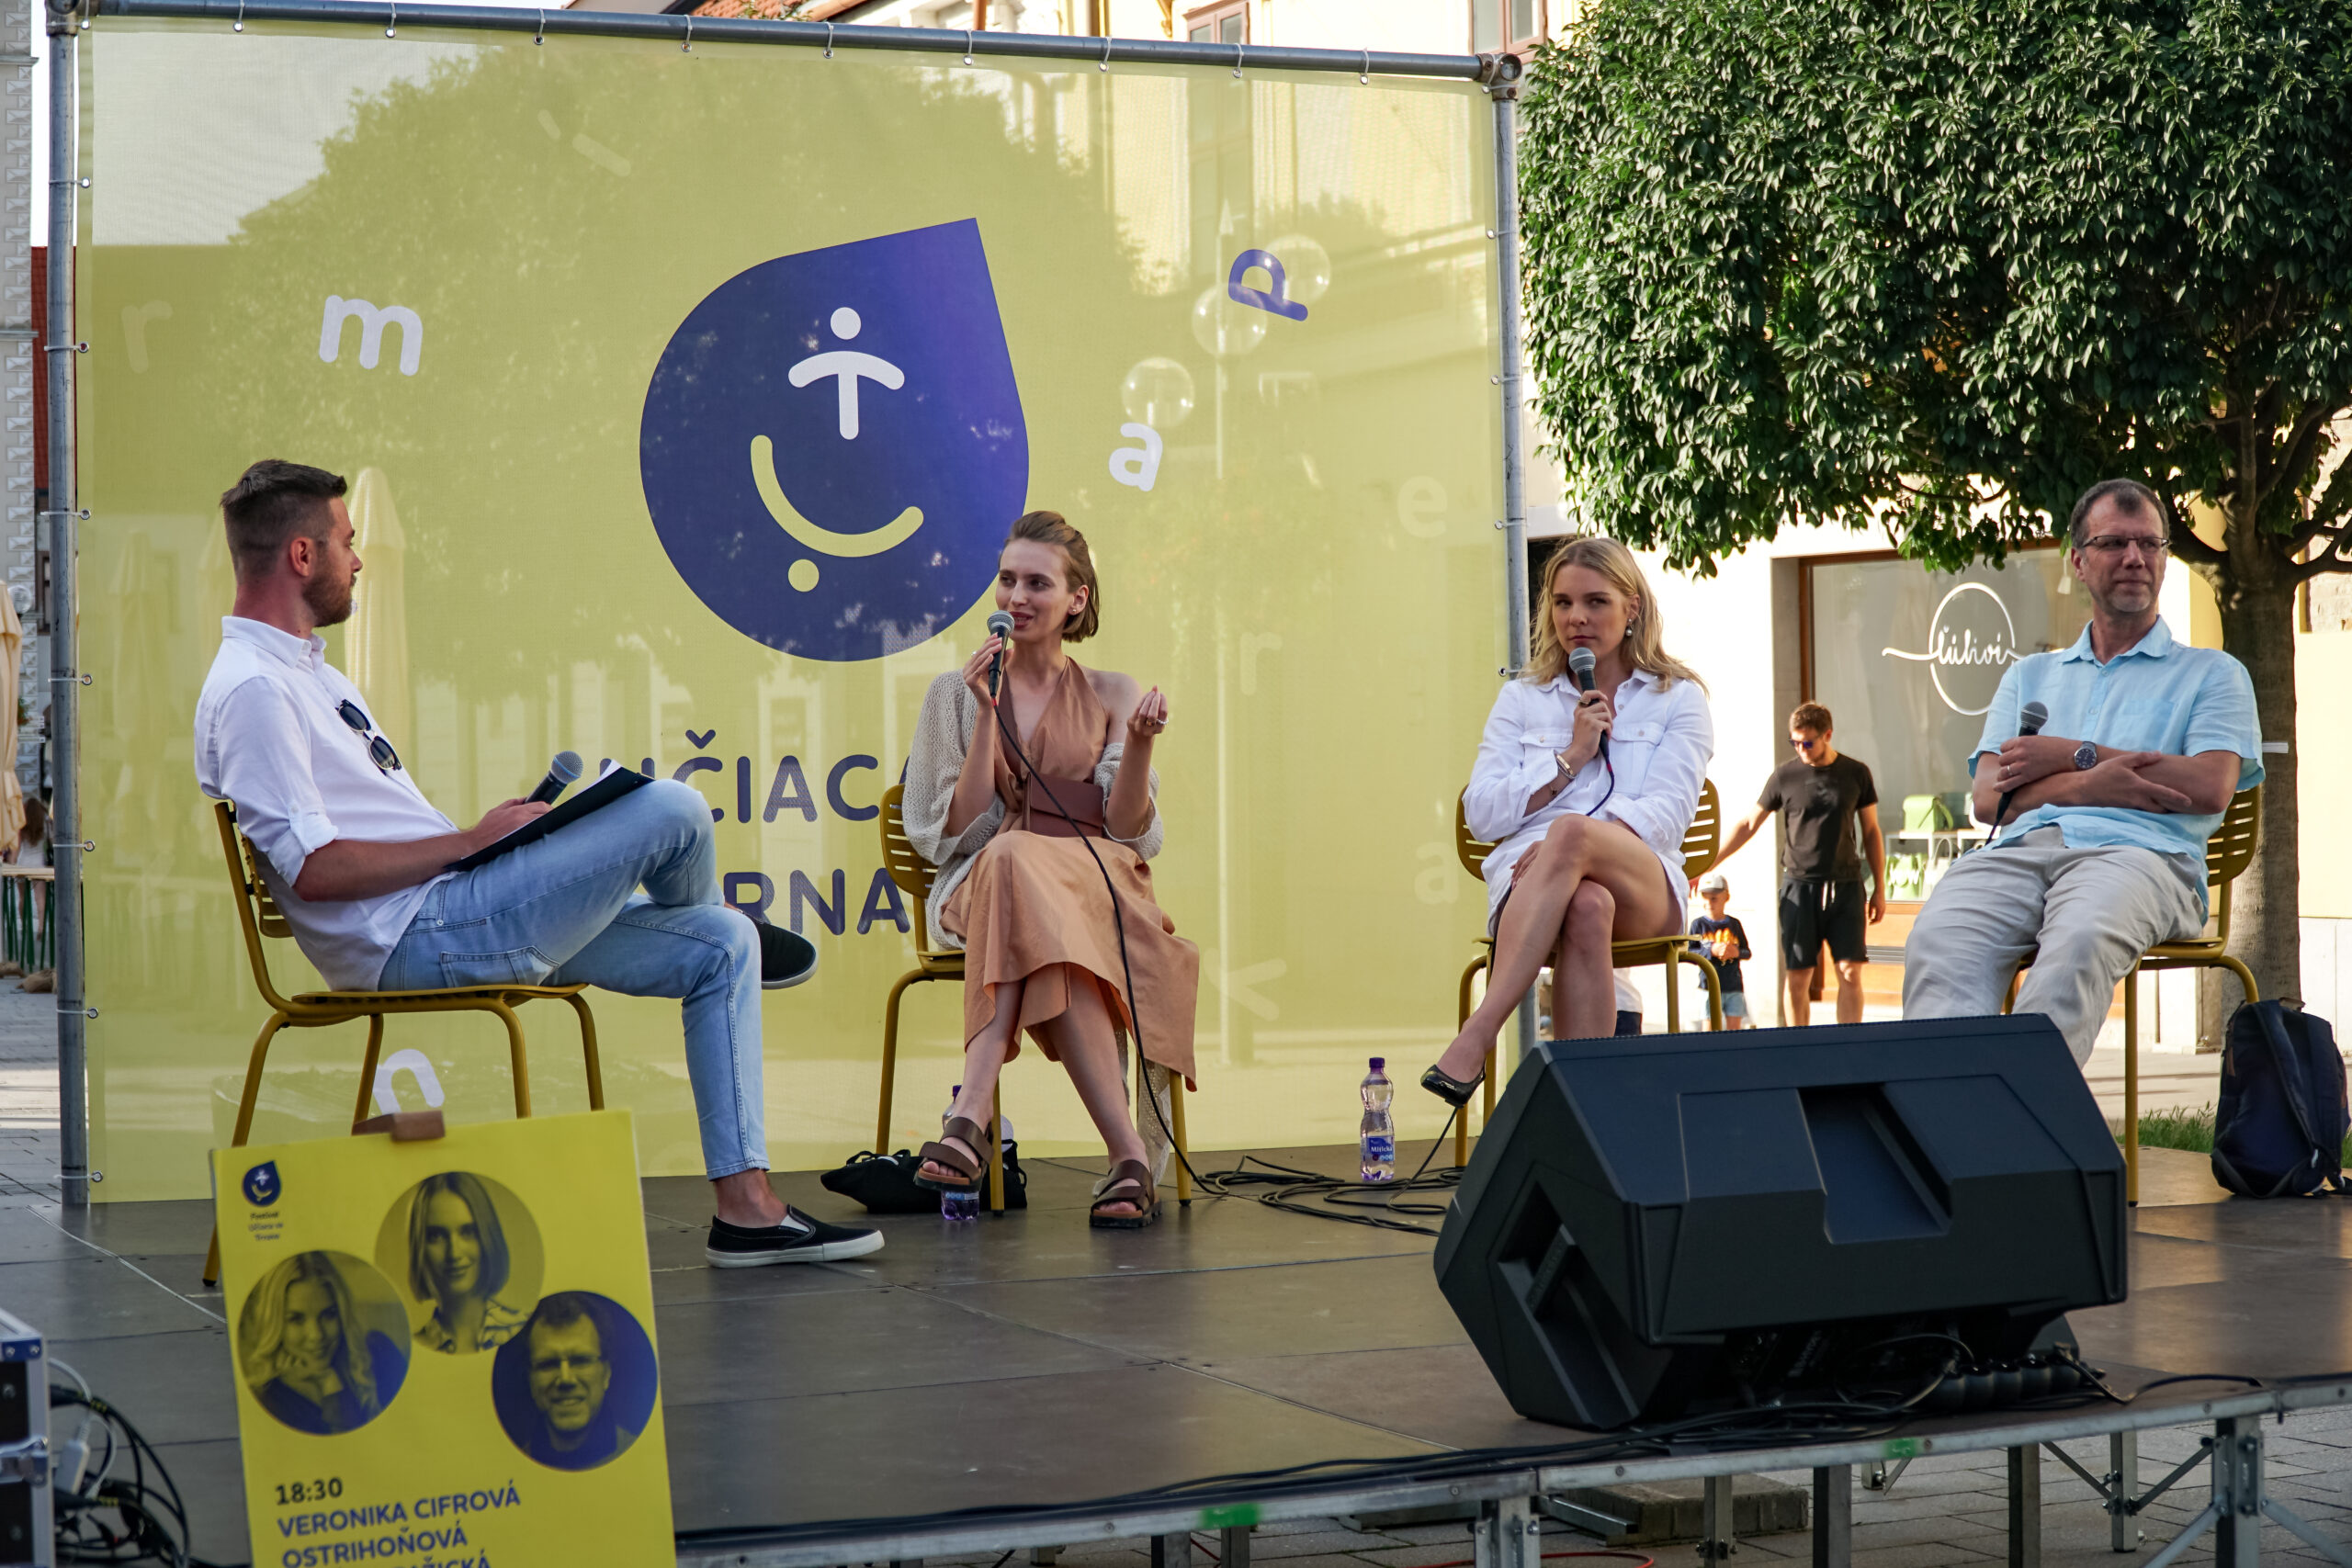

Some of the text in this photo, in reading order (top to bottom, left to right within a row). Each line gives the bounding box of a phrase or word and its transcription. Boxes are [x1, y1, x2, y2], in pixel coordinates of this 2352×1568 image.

[319, 294, 424, 377] m
[1108, 422, 1163, 492] a
[1396, 475, 1449, 539] e
[276, 1477, 343, 1506] 18:30
[277, 1478, 521, 1539] VERONIKA CIFROVÁ
[282, 1519, 468, 1568] OSTRIHOŇOVÁ
